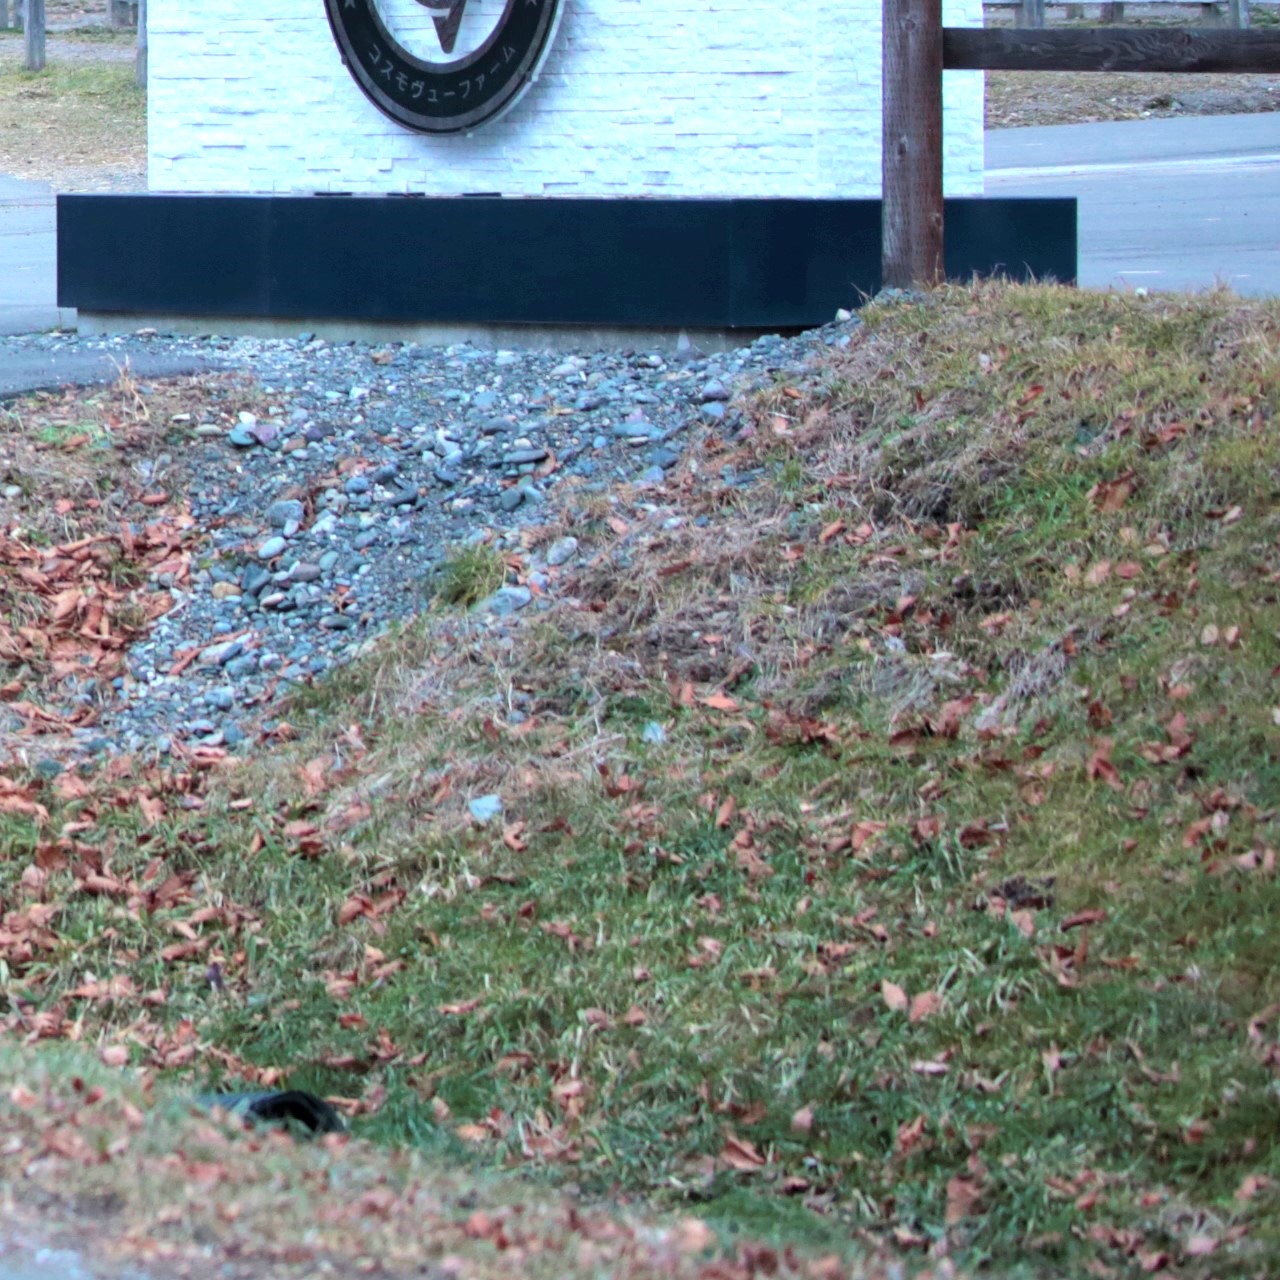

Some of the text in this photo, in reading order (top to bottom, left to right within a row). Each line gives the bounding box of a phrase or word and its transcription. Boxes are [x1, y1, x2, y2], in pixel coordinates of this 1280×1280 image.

[368, 43, 516, 102] コスモヴューファーム
